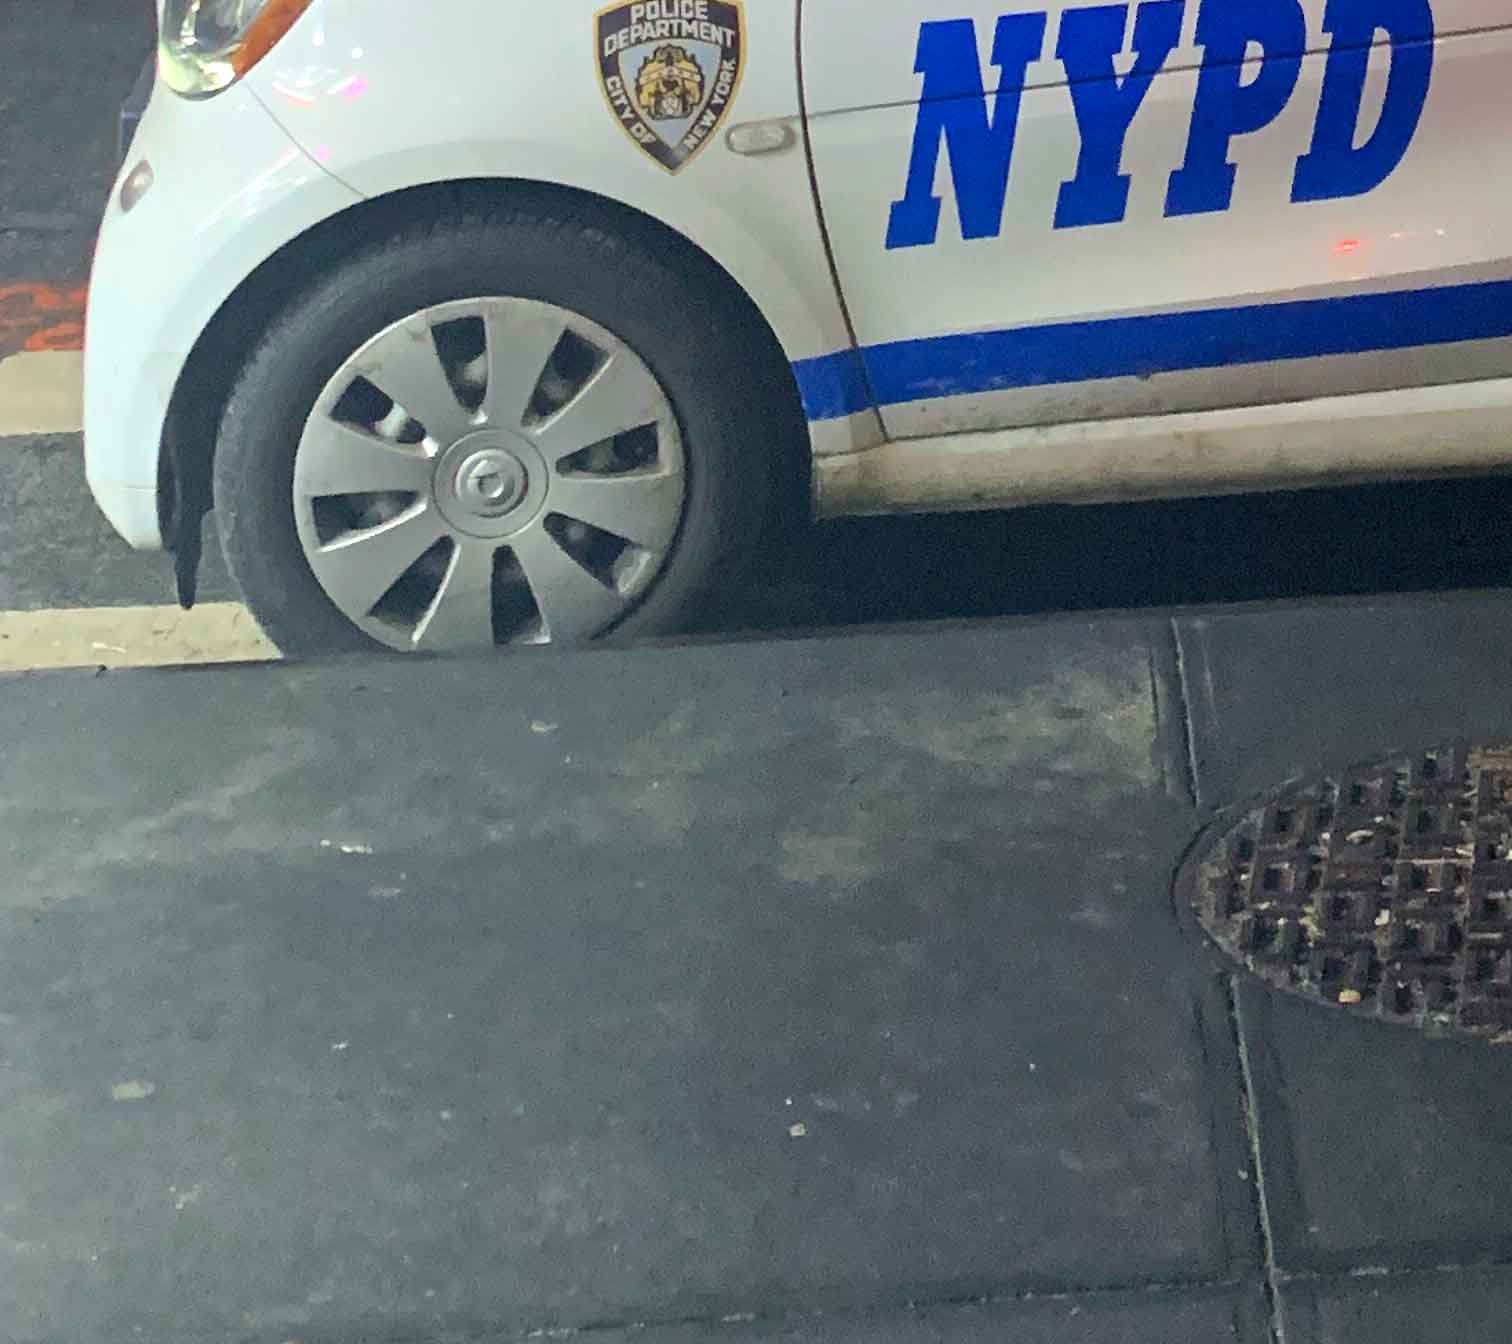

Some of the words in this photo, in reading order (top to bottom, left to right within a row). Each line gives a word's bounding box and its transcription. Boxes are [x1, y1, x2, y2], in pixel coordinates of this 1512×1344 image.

[604, 18, 736, 57] DEPARTMENT
[605, 75, 635, 120] CITY
[683, 106, 718, 151] NEW
[712, 57, 738, 106] YORK
